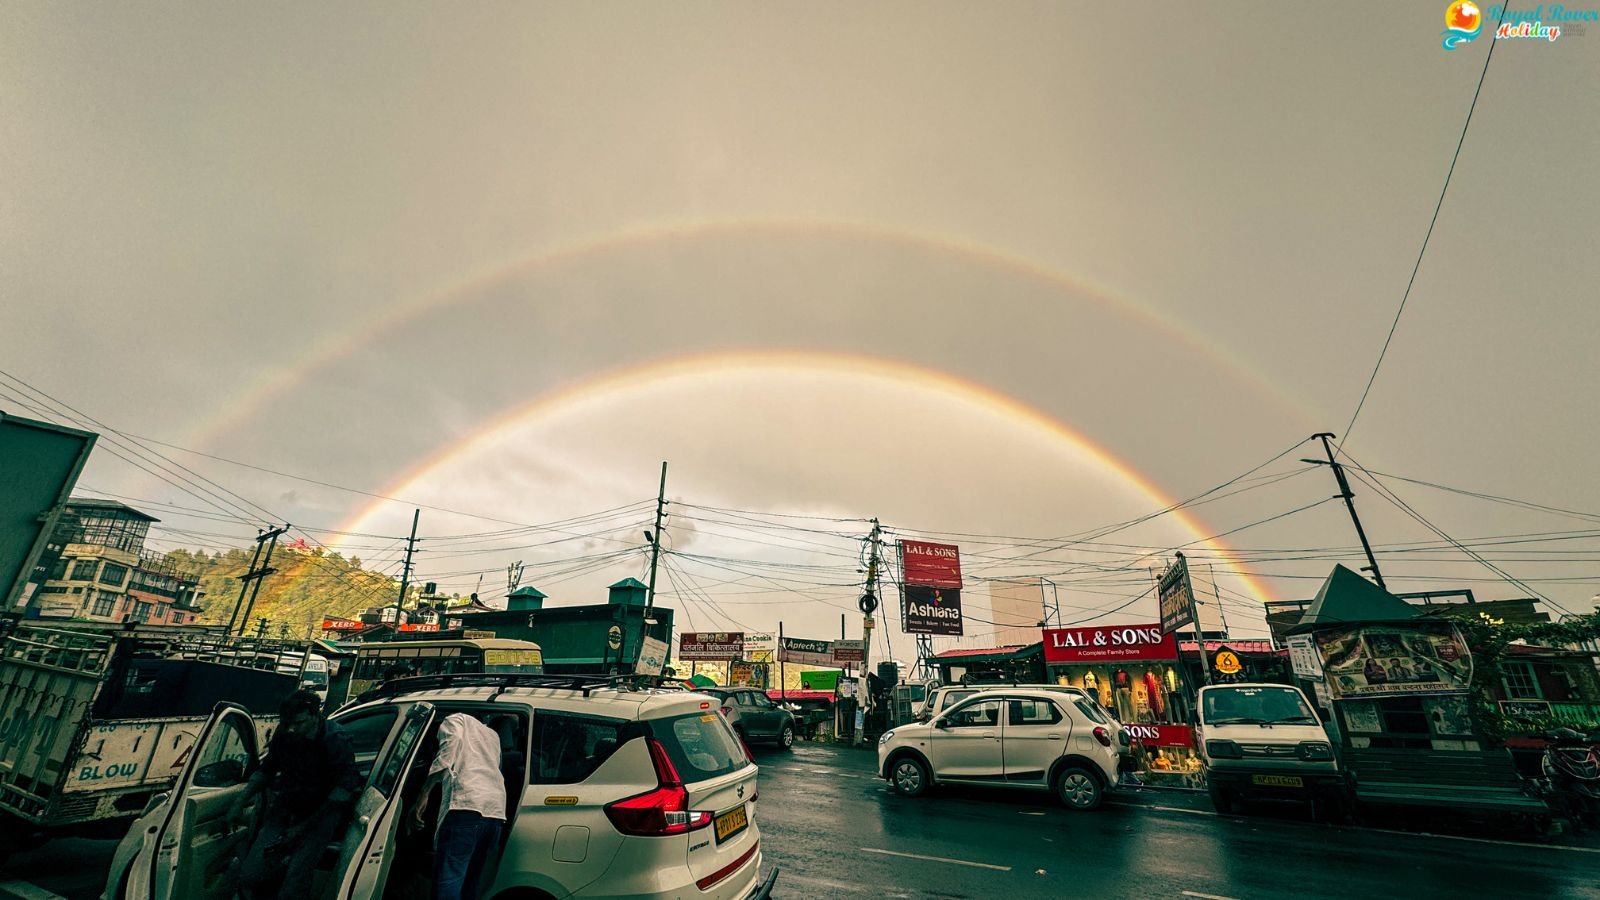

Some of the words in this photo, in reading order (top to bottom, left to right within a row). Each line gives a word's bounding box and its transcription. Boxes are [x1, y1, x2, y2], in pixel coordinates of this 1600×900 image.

[906, 545, 925, 555] LAL
[925, 547, 933, 556] &
[934, 548, 957, 558] SONS
[909, 602, 959, 619] Ashiana
[787, 639, 816, 651] Aptech
[1053, 632, 1089, 648] LAL
[1093, 631, 1107, 646] &
[1111, 628, 1162, 645] SONS
[1123, 726, 1160, 739] SONS
[80, 763, 138, 780] BLOW
